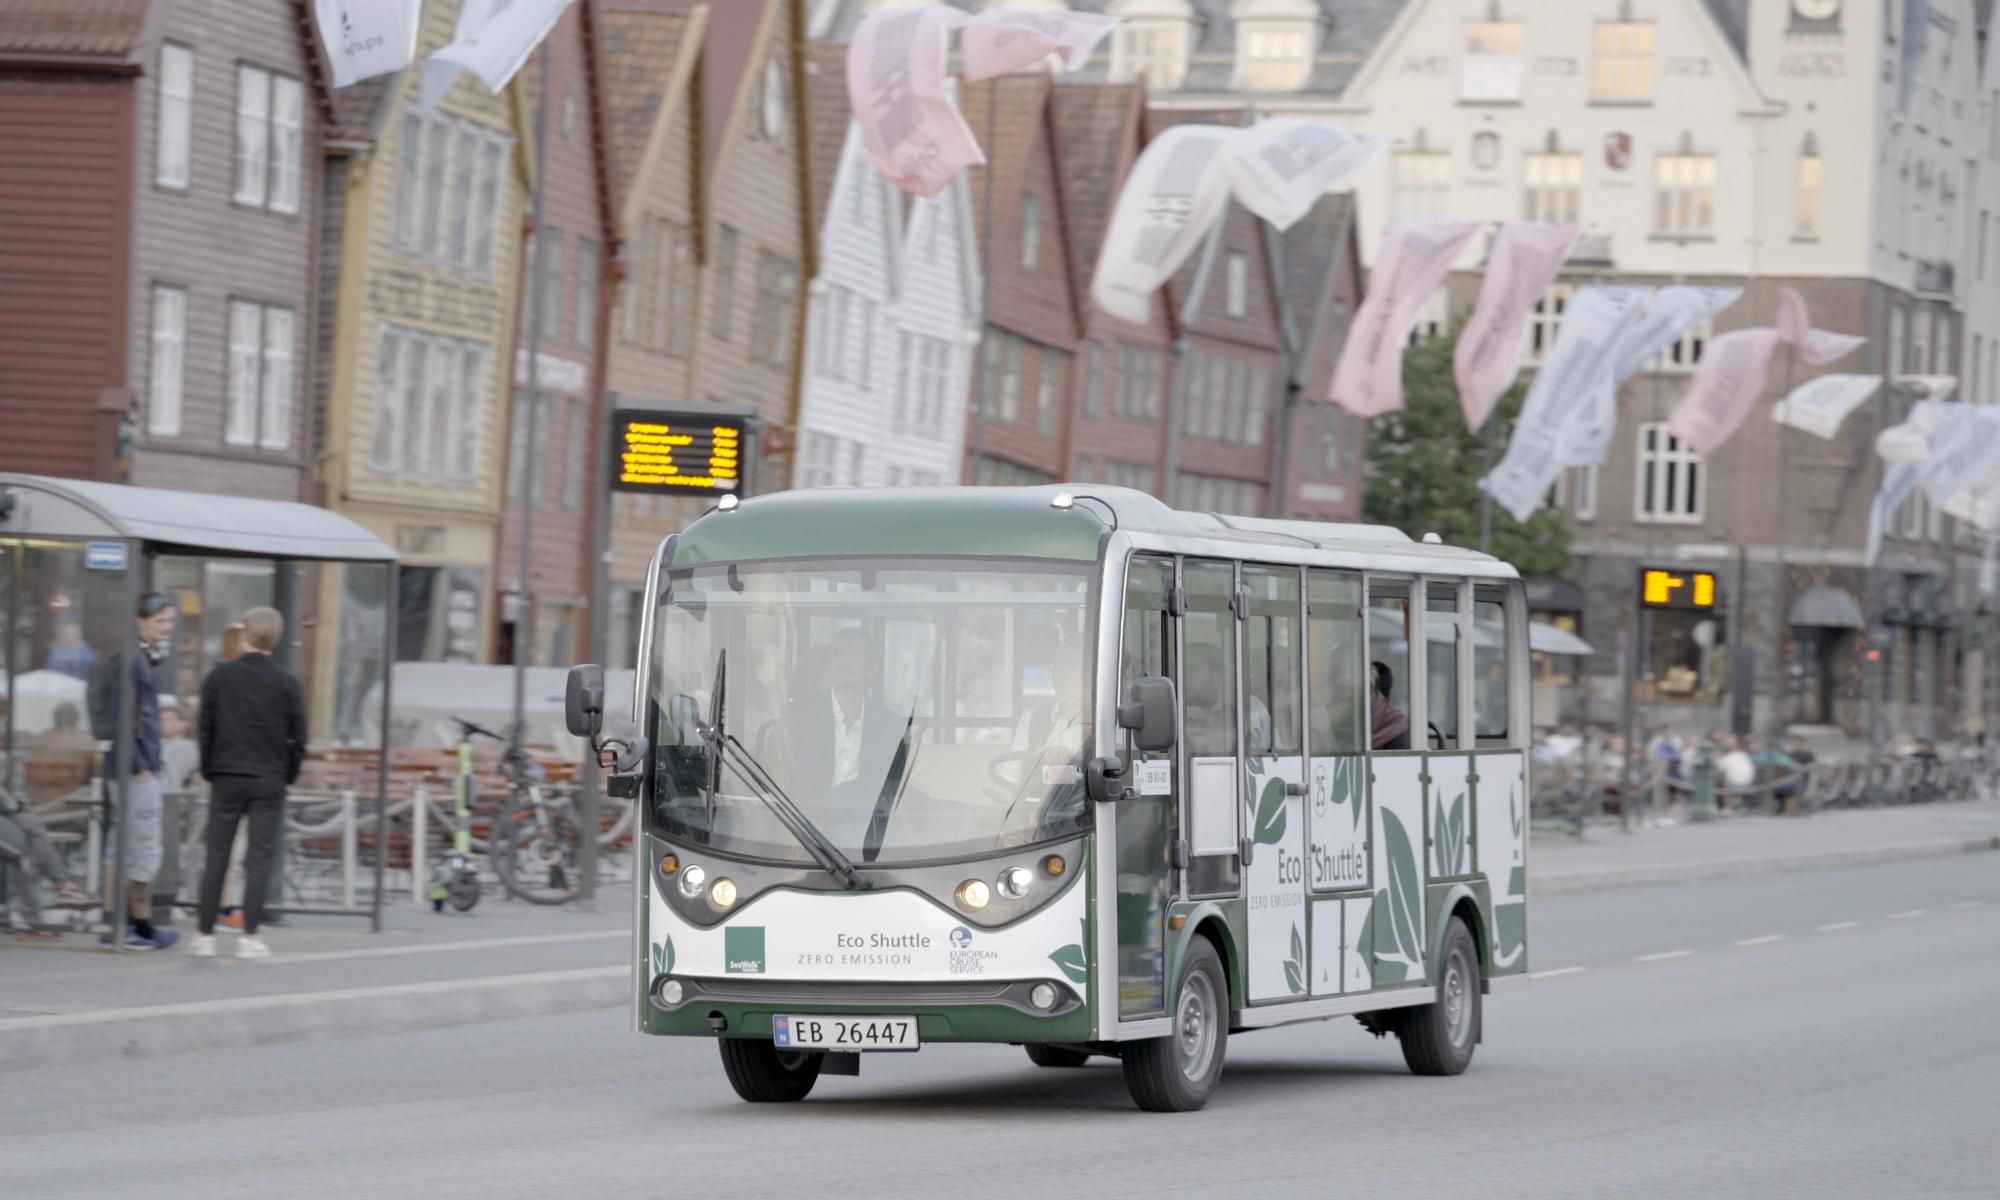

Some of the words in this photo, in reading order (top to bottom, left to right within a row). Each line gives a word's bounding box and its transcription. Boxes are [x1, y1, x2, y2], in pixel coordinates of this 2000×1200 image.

[1316, 775, 1325, 807] 25
[1278, 848, 1301, 884] Eco
[1315, 843, 1363, 883] Shuttle
[1250, 895, 1268, 910] ZERO
[838, 933, 864, 948] Eco
[870, 932, 931, 948] Shuttle
[797, 954, 834, 965] ZERO
[841, 954, 912, 965] EMISSION
[949, 951, 998, 959] EUROPEAN
[949, 959, 981, 967] CRUISE
[949, 967, 985, 975] SERVICE
[795, 1021, 823, 1043] EB
[835, 1022, 908, 1044] 26447
